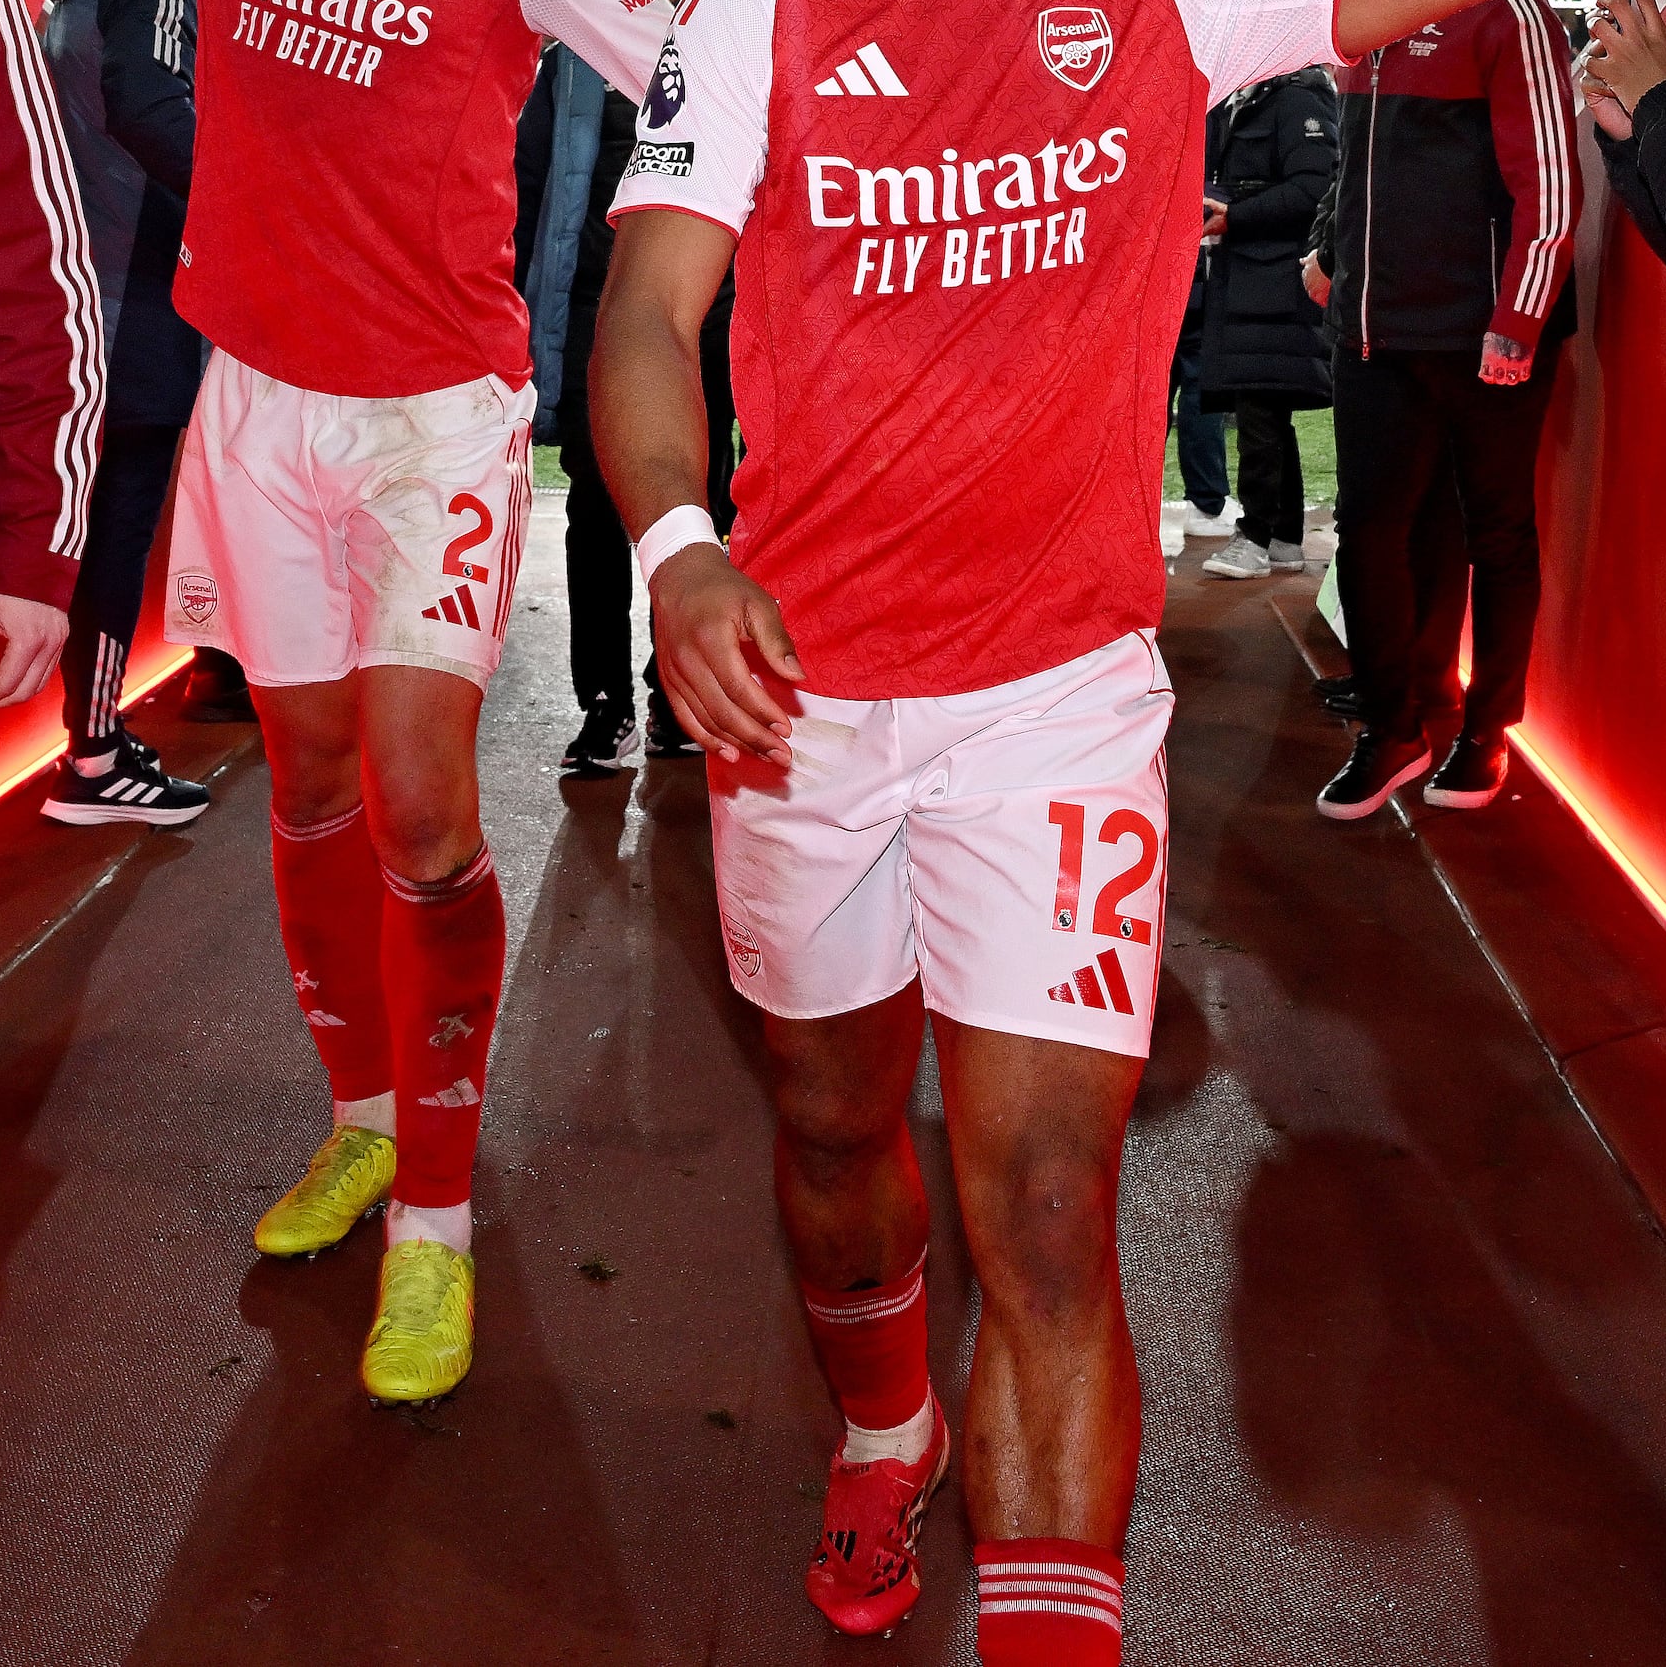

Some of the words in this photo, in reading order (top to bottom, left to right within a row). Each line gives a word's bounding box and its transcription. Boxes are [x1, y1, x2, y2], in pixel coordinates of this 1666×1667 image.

[233, 1, 276, 51] FLY
[275, 18, 383, 88] BETTER
[1047, 19, 1099, 37] Arsenal
[638, 144, 687, 162] room
[803, 127, 1129, 227] Emirates
[852, 235, 928, 295] FLY
[941, 206, 1087, 288] BETTER
[442, 492, 493, 584] 2
[183, 583, 212, 593] Arsenal
[1047, 799, 1160, 947] 12
